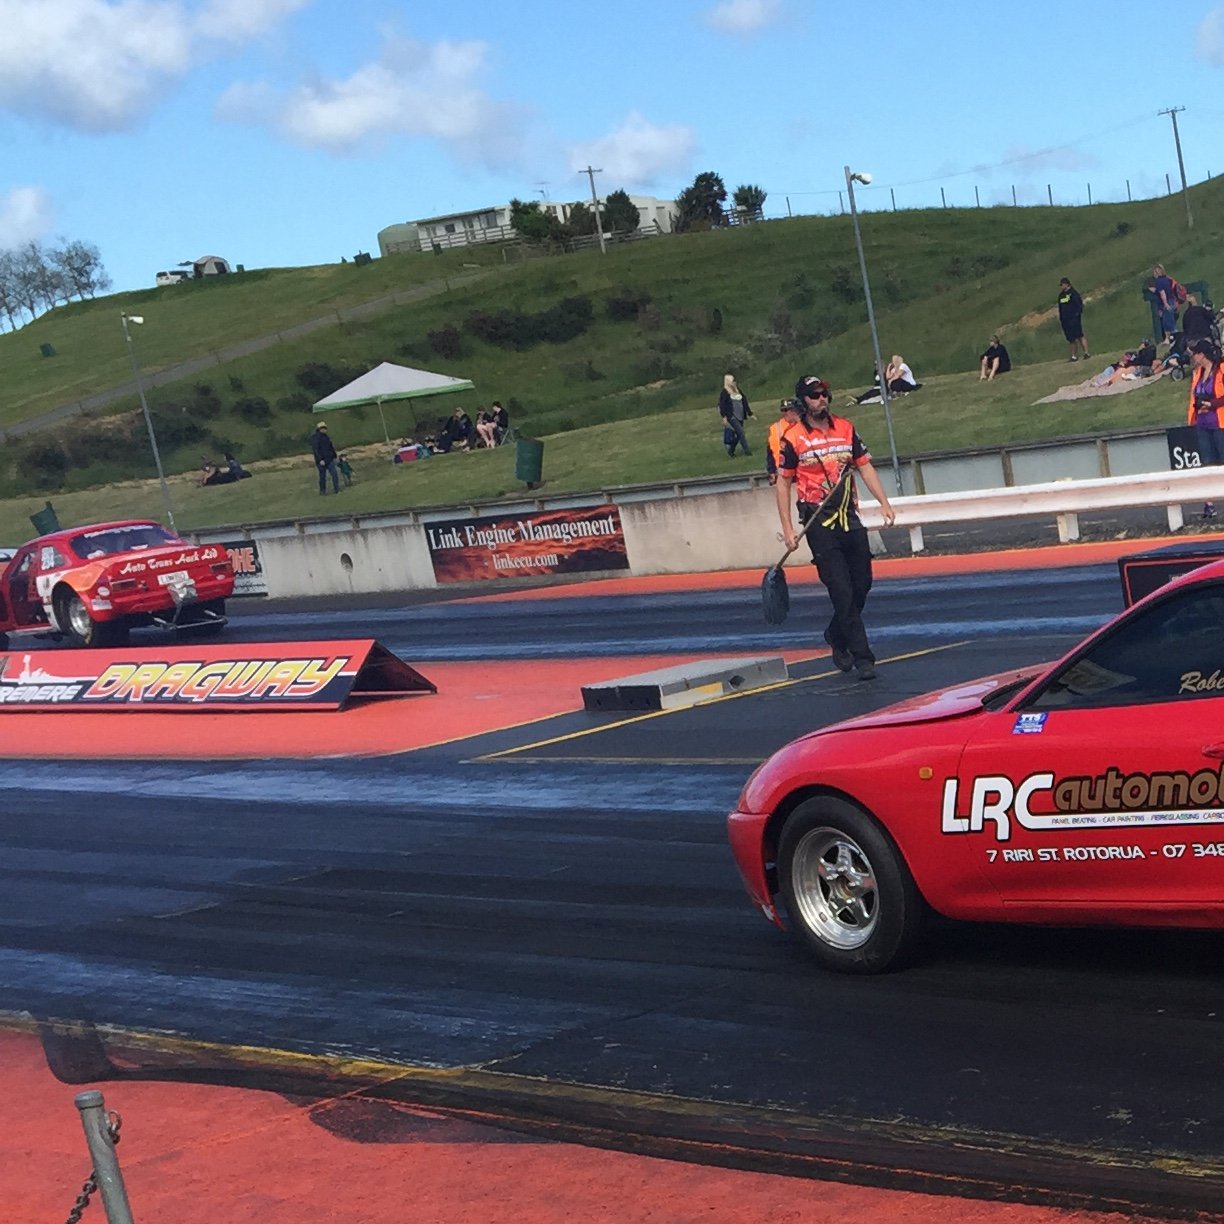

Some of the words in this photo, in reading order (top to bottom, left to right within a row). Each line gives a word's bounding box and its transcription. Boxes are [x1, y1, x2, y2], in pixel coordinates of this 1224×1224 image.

[428, 527, 464, 550] Link
[466, 523, 516, 550] Engine
[518, 515, 616, 544] Management
[120, 562, 146, 574] Auto
[147, 558, 173, 569] Trans
[492, 553, 559, 570] linkecu.com
[83, 657, 349, 702] DRAGWAY
[943, 774, 1054, 840] LRC
[986, 849, 998, 863] 7
[1004, 847, 1035, 862] RIRI
[1064, 845, 1145, 860] ROTORUA
[1163, 844, 1186, 858] 07
